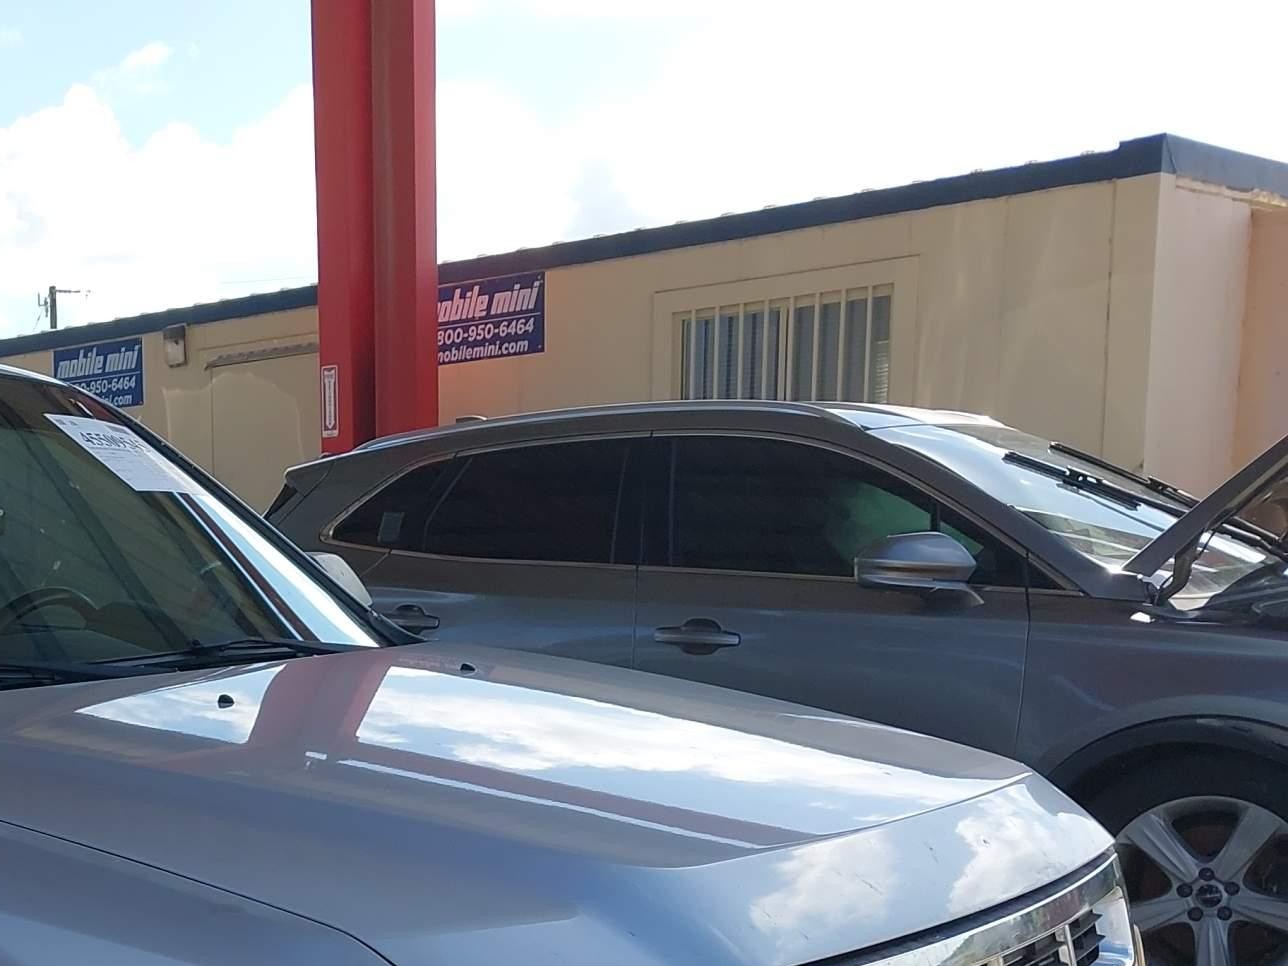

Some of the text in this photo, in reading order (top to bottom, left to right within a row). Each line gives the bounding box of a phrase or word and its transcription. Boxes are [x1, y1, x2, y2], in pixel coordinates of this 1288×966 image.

[438, 281, 540, 323] obile mini
[57, 345, 140, 379] mobile mini
[75, 375, 136, 394] 0-950-6464
